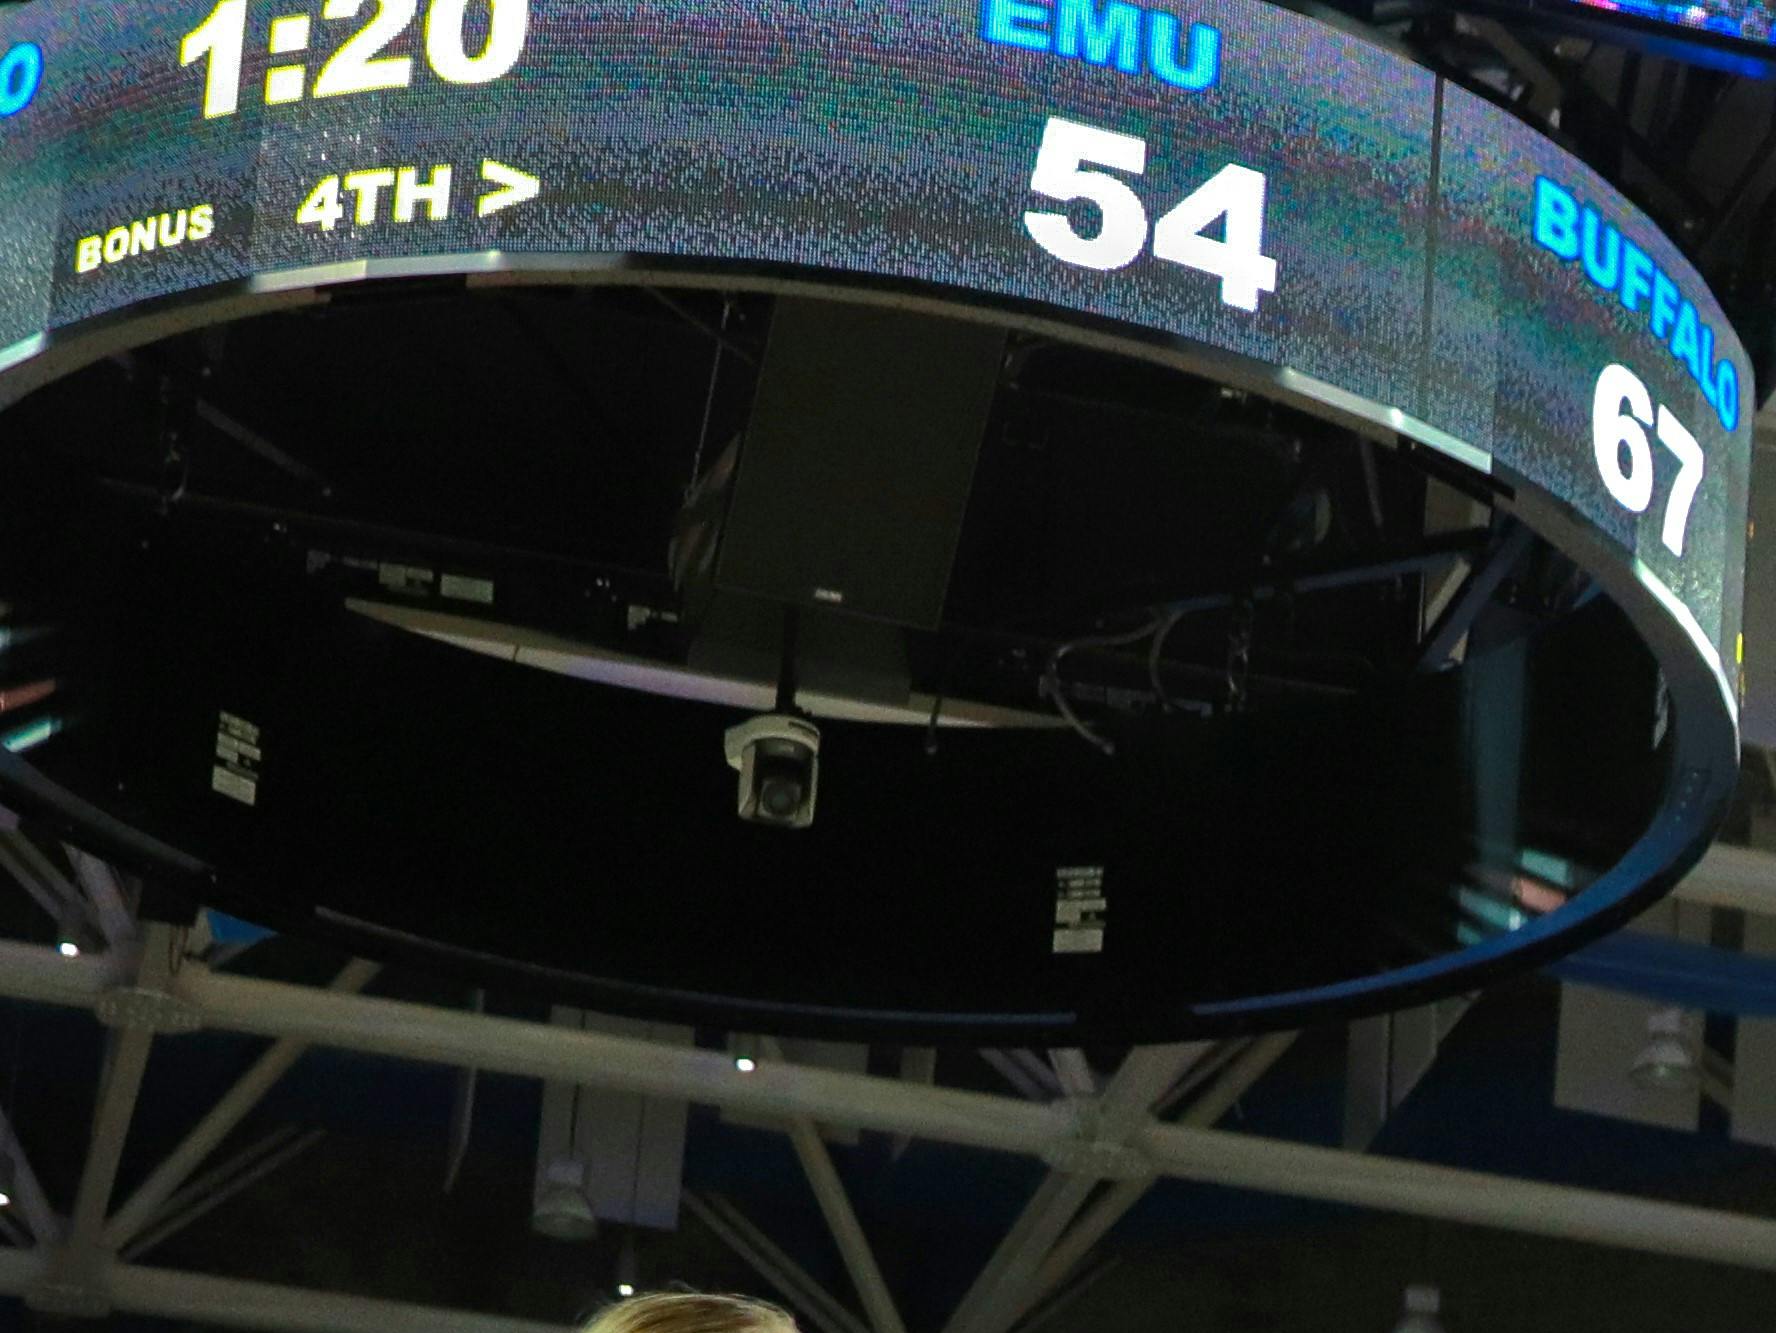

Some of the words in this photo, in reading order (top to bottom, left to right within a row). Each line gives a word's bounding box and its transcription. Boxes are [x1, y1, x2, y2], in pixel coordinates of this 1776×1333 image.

[179, 0, 531, 119] 1:20
[980, 0, 1222, 91] EMU
[75, 203, 214, 275] BONUS
[297, 164, 452, 233] 4TH
[1023, 116, 1277, 313] 54
[1533, 176, 1740, 433] BUFFALO
[1592, 363, 1705, 558] 67
